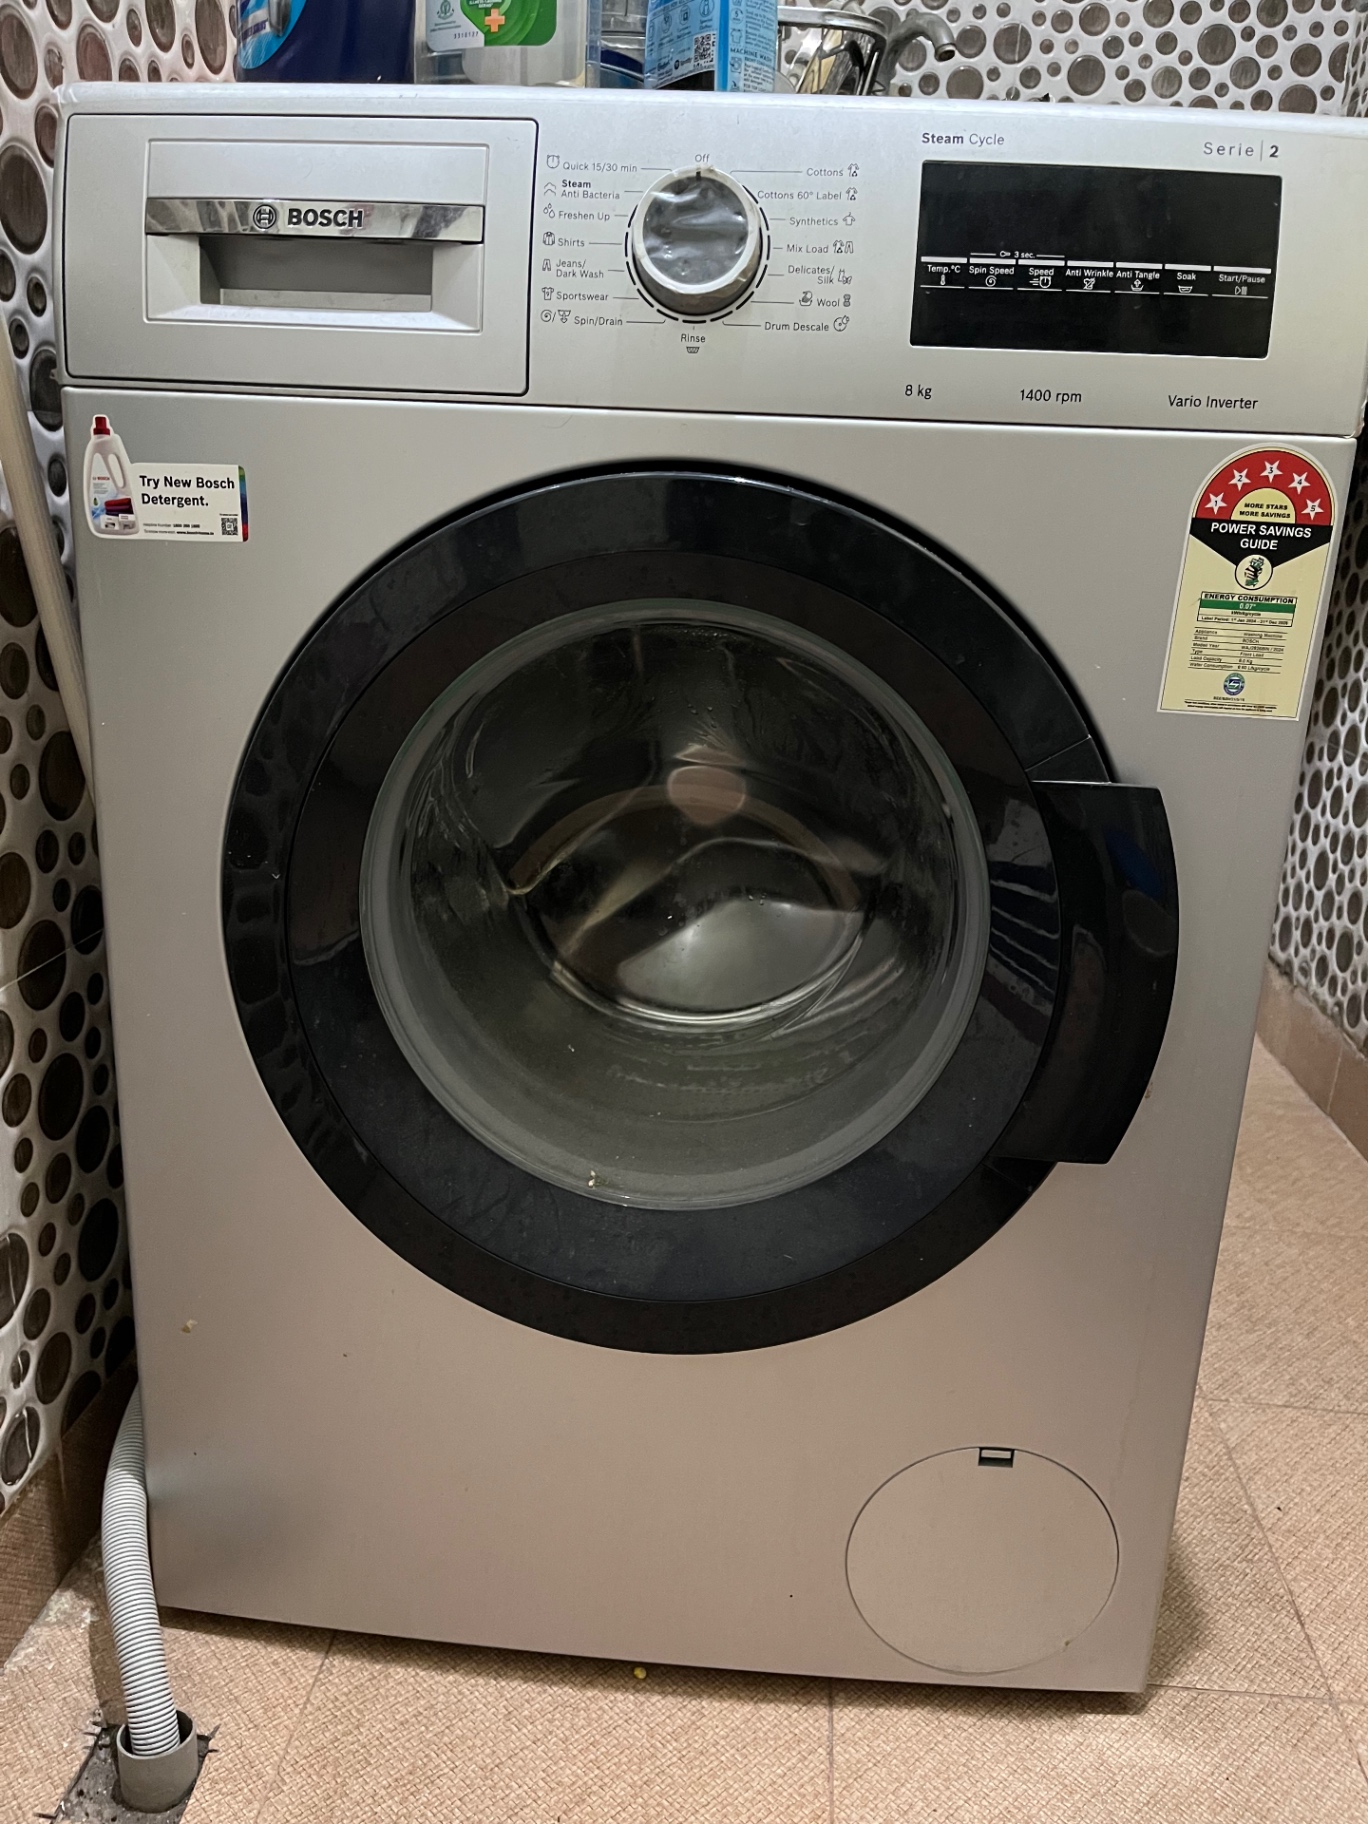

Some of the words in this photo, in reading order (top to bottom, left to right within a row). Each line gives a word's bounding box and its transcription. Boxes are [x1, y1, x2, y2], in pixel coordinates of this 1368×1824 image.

[730, 48, 758, 58] MACHINE
[922, 132, 964, 144] Steam
[969, 133, 1004, 147] Cycle
[1203, 142, 1254, 157] Serie
[1269, 144, 1279, 158] 2
[694, 154, 710, 162] Off
[562, 161, 589, 171] Quick
[592, 162, 618, 172] 15/30
[620, 164, 638, 172] min
[806, 168, 844, 177] Cottons
[562, 179, 591, 188] Steam
[561, 190, 579, 198] Anti
[582, 190, 620, 200] Bacteria
[757, 190, 794, 199] Cottons
[797, 191, 813, 199] 60°
[816, 192, 842, 200] Label
[287, 208, 363, 228] BOSCH
[558, 211, 594, 220] Freshen
[597, 212, 610, 221] Up
[789, 217, 839, 227] Synthetics
[557, 238, 585, 247] Shirts
[786, 244, 803, 253] Mix
[806, 245, 829, 253] Load
[556, 259, 586, 268] Jeans/
[556, 269, 579, 278] Dark
[579, 270, 604, 278] Wash
[788, 265, 835, 276] Delicates/
[969, 266, 987, 274] Spin
[989, 266, 1014, 275] Speed
[1028, 268, 1054, 276] Speed
[817, 276, 834, 284] Silk
[1135, 271, 1160, 280] Tangle
[1176, 272, 1196, 280] Soak
[1219, 274, 1266, 283] Start/Pause
[556, 292, 609, 301] Sportswear
[816, 298, 840, 307] Wool
[574, 316, 623, 326] Spin/Drain
[764, 322, 790, 330] Drum
[793, 322, 829, 331] Descale
[680, 334, 706, 343] Rinse
[905, 384, 914, 397] 8
[917, 384, 932, 400] kg
[1019, 389, 1051, 402] 1400
[1055, 392, 1082, 403] rpm
[1168, 395, 1202, 408] Vario
[1206, 396, 1258, 409] Inverter
[139, 475, 160, 489] Try
[164, 476, 191, 488] New
[196, 477, 235, 489] Bosch
[141, 494, 209, 508] Detergent.
[1211, 522, 1256, 535] POWER
[1259, 525, 1312, 538] SAVINGS
[1240, 538, 1278, 550] GUIDE
[1238, 595, 1294, 603] CONSUMPTION
